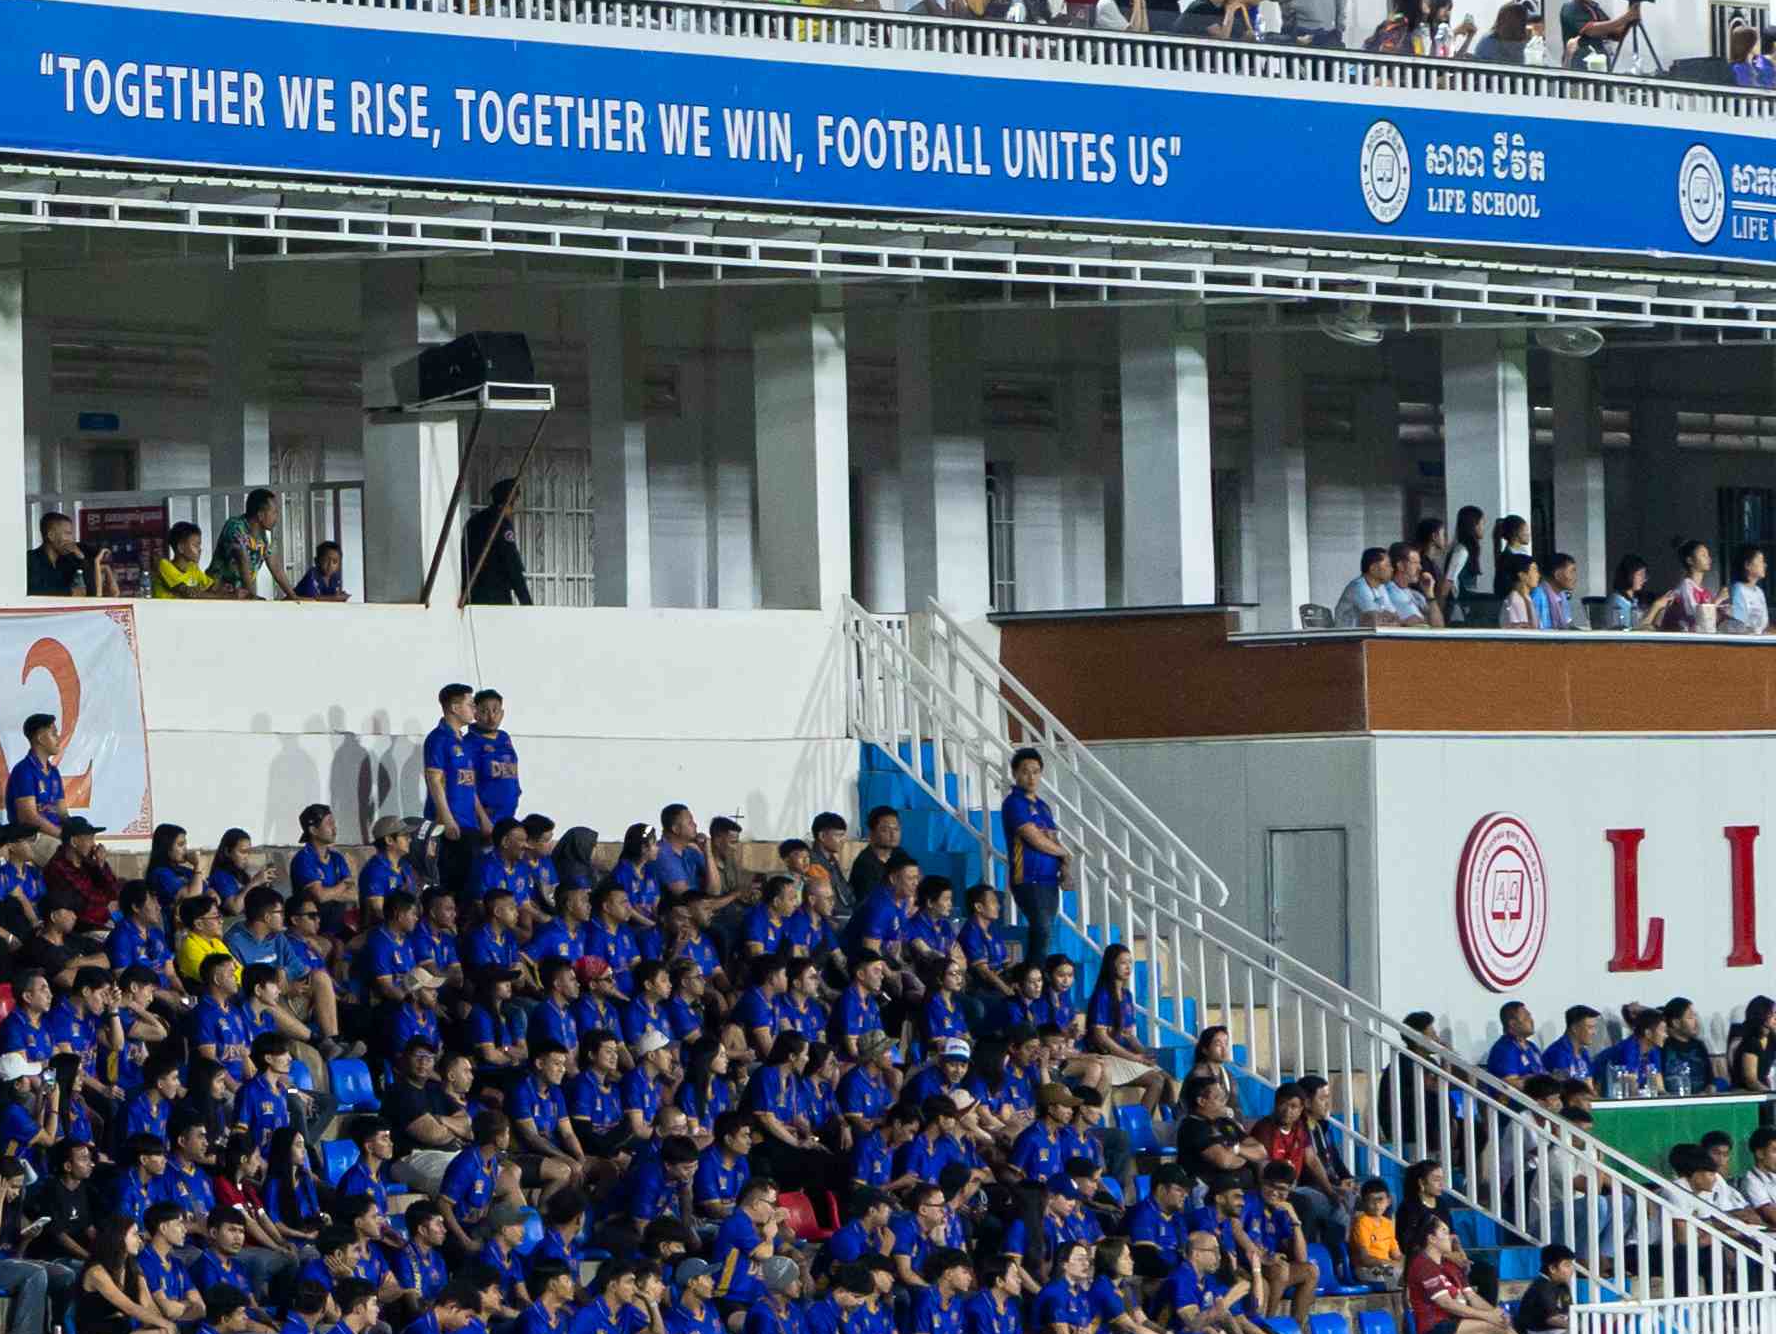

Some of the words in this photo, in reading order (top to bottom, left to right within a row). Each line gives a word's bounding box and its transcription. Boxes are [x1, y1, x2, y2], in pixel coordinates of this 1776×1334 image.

[279, 75, 338, 132] WE
[353, 81, 441, 148] RISE,
[455, 87, 645, 153] TOGETHER
[659, 102, 710, 158] WE
[724, 107, 803, 173] WIN,
[818, 114, 991, 175] FOOTBALL
[1002, 127, 1115, 181] UNITES
[1428, 187, 1466, 214] LIFE
[1472, 190, 1540, 218] SCHOOL
[1733, 215, 1768, 241] LIFE
